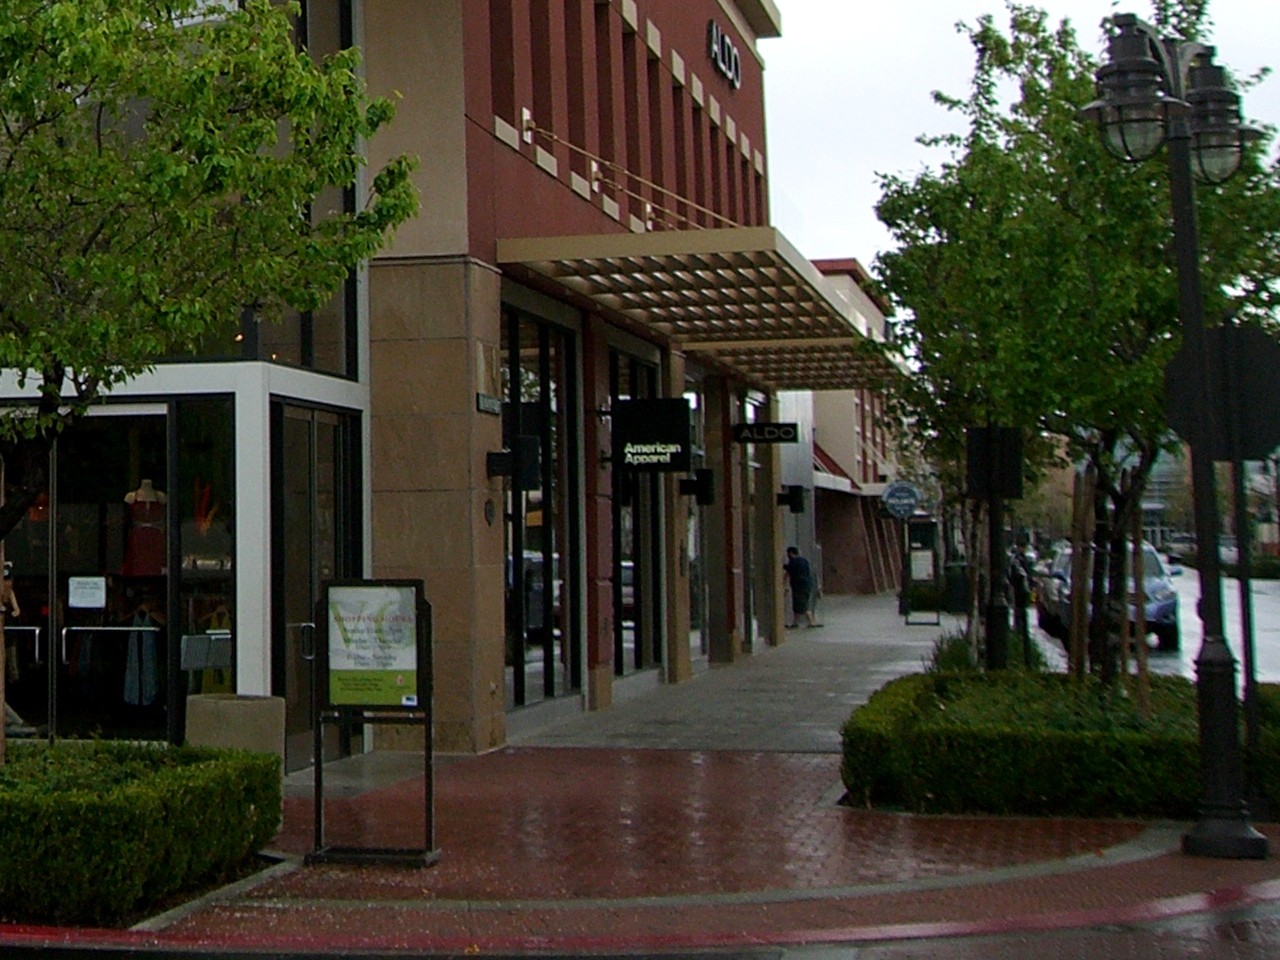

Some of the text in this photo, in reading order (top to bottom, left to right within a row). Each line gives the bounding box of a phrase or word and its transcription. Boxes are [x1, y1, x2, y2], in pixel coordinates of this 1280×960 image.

[709, 19, 742, 90] ALDO
[739, 427, 795, 439] ALDO
[623, 442, 682, 454] American
[623, 453, 670, 465] Apparel
